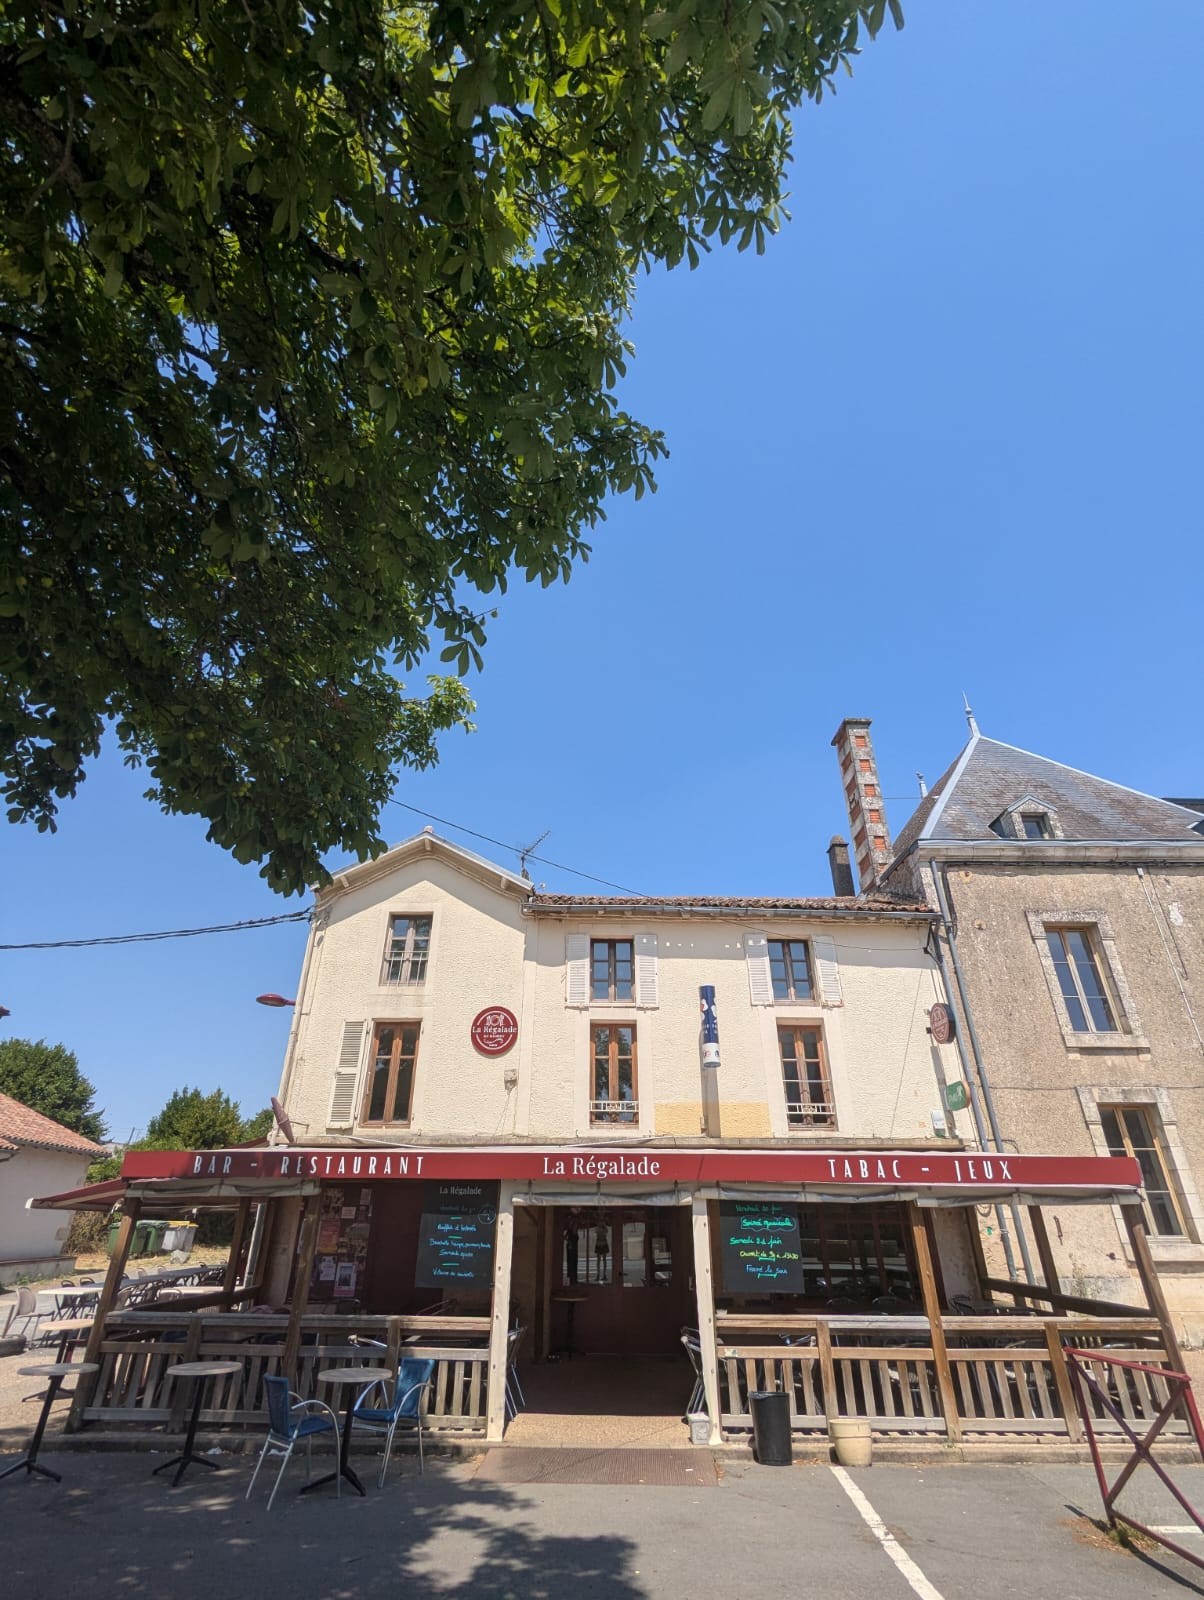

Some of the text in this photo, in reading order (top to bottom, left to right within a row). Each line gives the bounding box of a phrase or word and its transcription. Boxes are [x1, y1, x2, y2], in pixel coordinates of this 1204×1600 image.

[193, 1156, 232, 1174] BAR
[281, 1156, 424, 1175] RESTAURANT
[543, 1155, 660, 1179] La Régalade
[828, 1159, 901, 1179] TABAC
[954, 1160, 1012, 1182] JEUX
